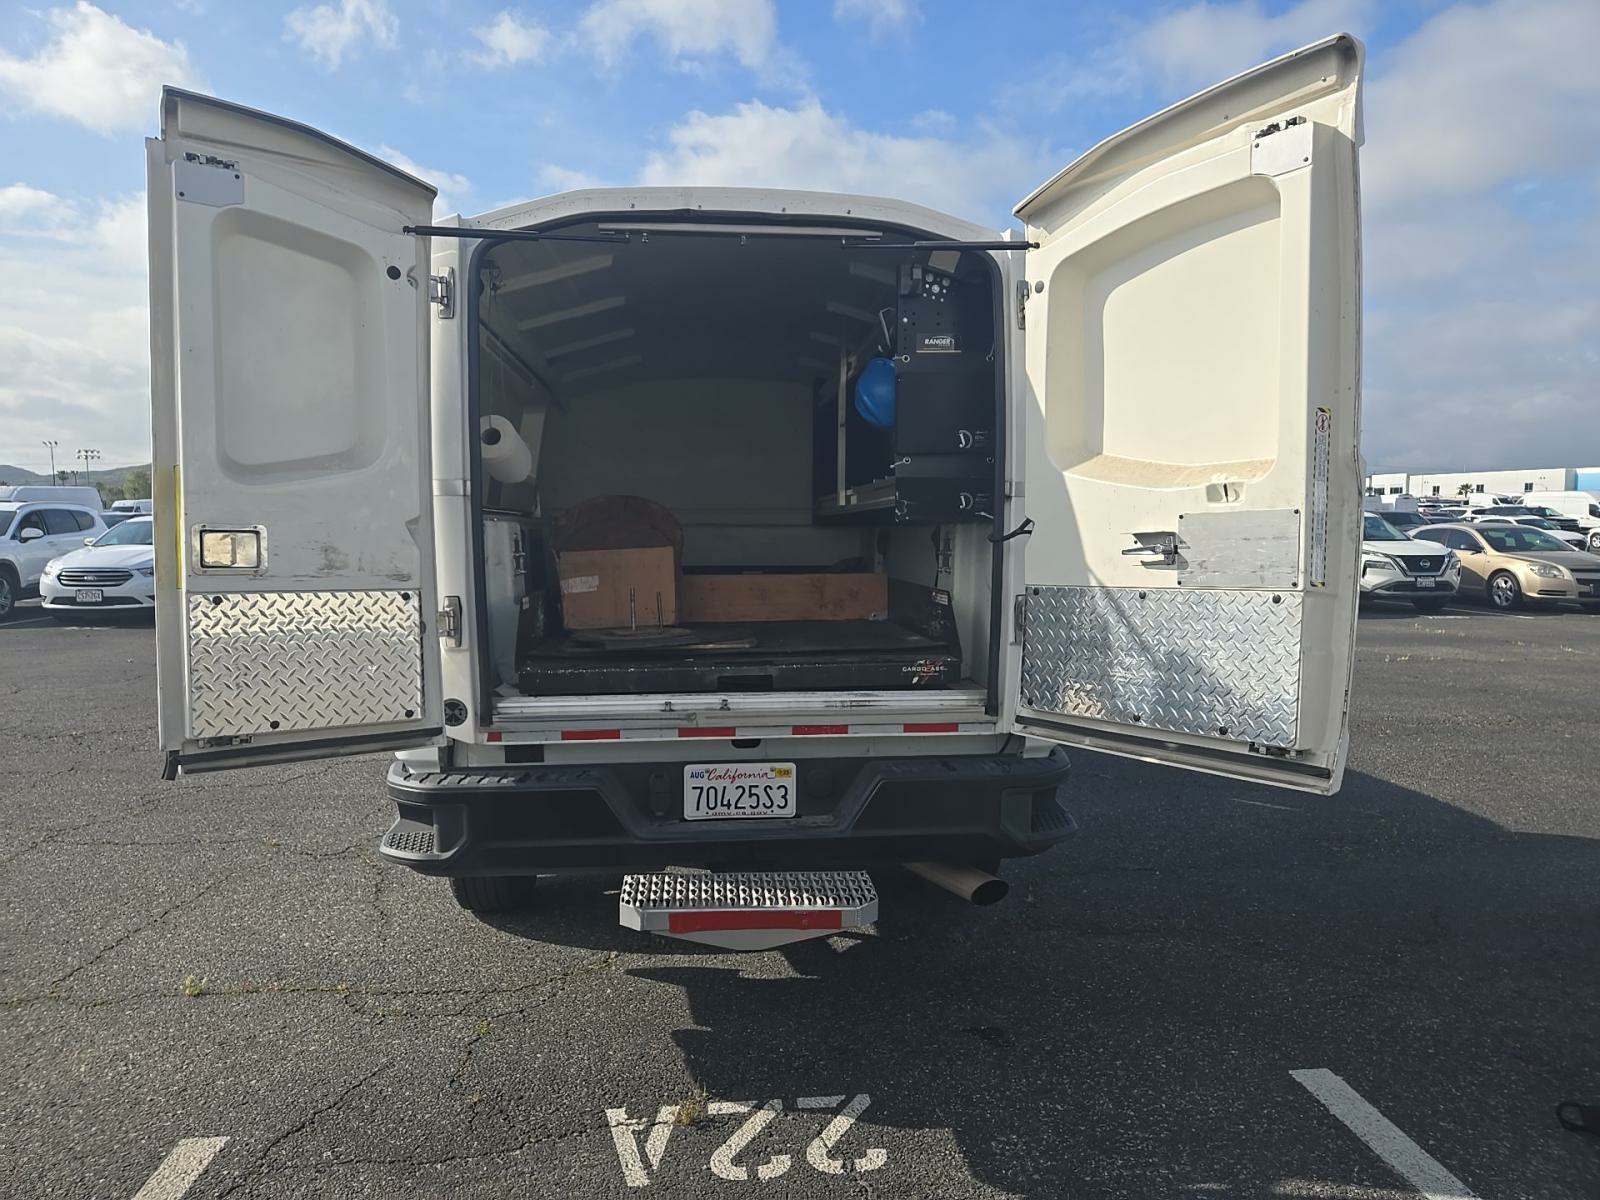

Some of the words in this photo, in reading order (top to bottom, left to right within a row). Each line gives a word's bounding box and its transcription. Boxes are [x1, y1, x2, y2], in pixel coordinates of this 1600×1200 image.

[690, 771, 705, 780] AUG
[707, 768, 770, 783] California
[691, 784, 789, 812] 70425S3
[604, 1093, 888, 1187] 22A
